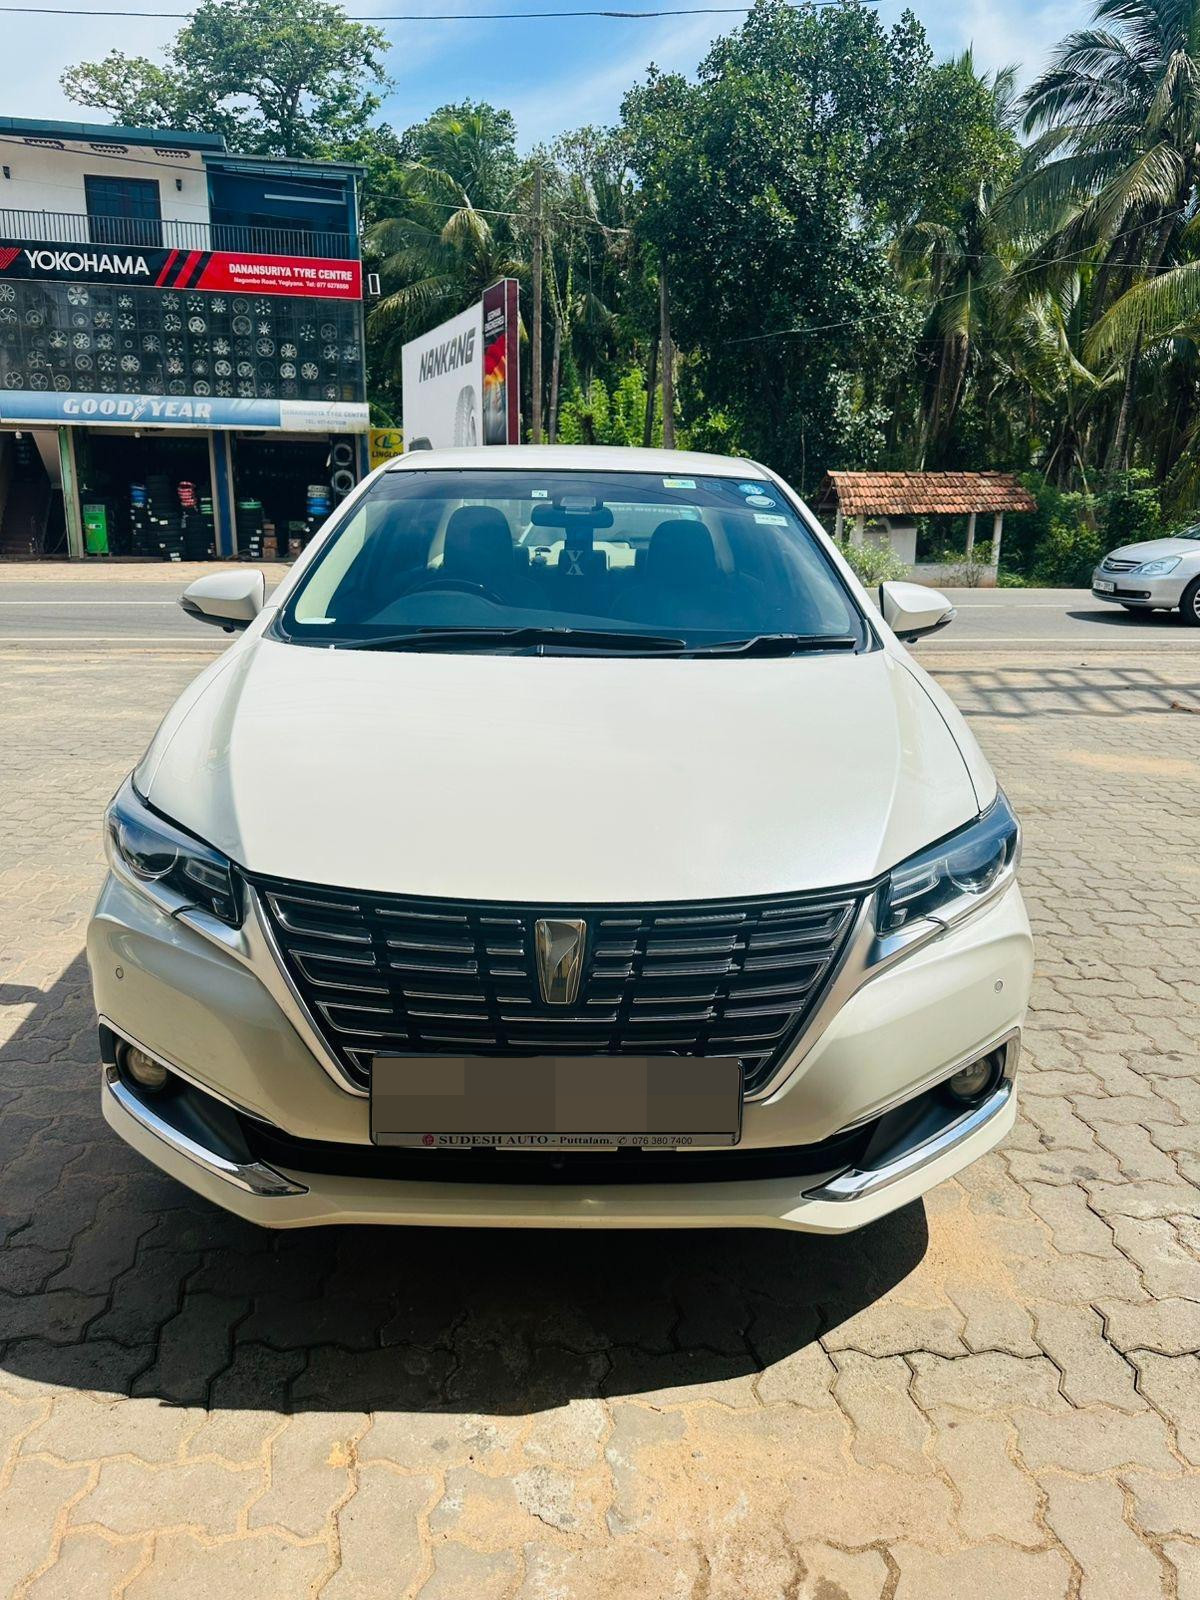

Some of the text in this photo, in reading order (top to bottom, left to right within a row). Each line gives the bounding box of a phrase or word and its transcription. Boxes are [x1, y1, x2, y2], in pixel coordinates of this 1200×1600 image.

[24, 250, 150, 276] YOKOHAMA
[229, 263, 353, 281] DANANSURIYA TYRE CENTRE
[418, 327, 476, 383] NANKANG
[439, 1135, 502, 1145] SUDESH
[506, 1135, 549, 1145] AUTO
[560, 1136, 613, 1146] Puttalam.
[632, 1136, 649, 1145] 076
[651, 1136, 668, 1145] 380
[670, 1136, 693, 1145] 7400
